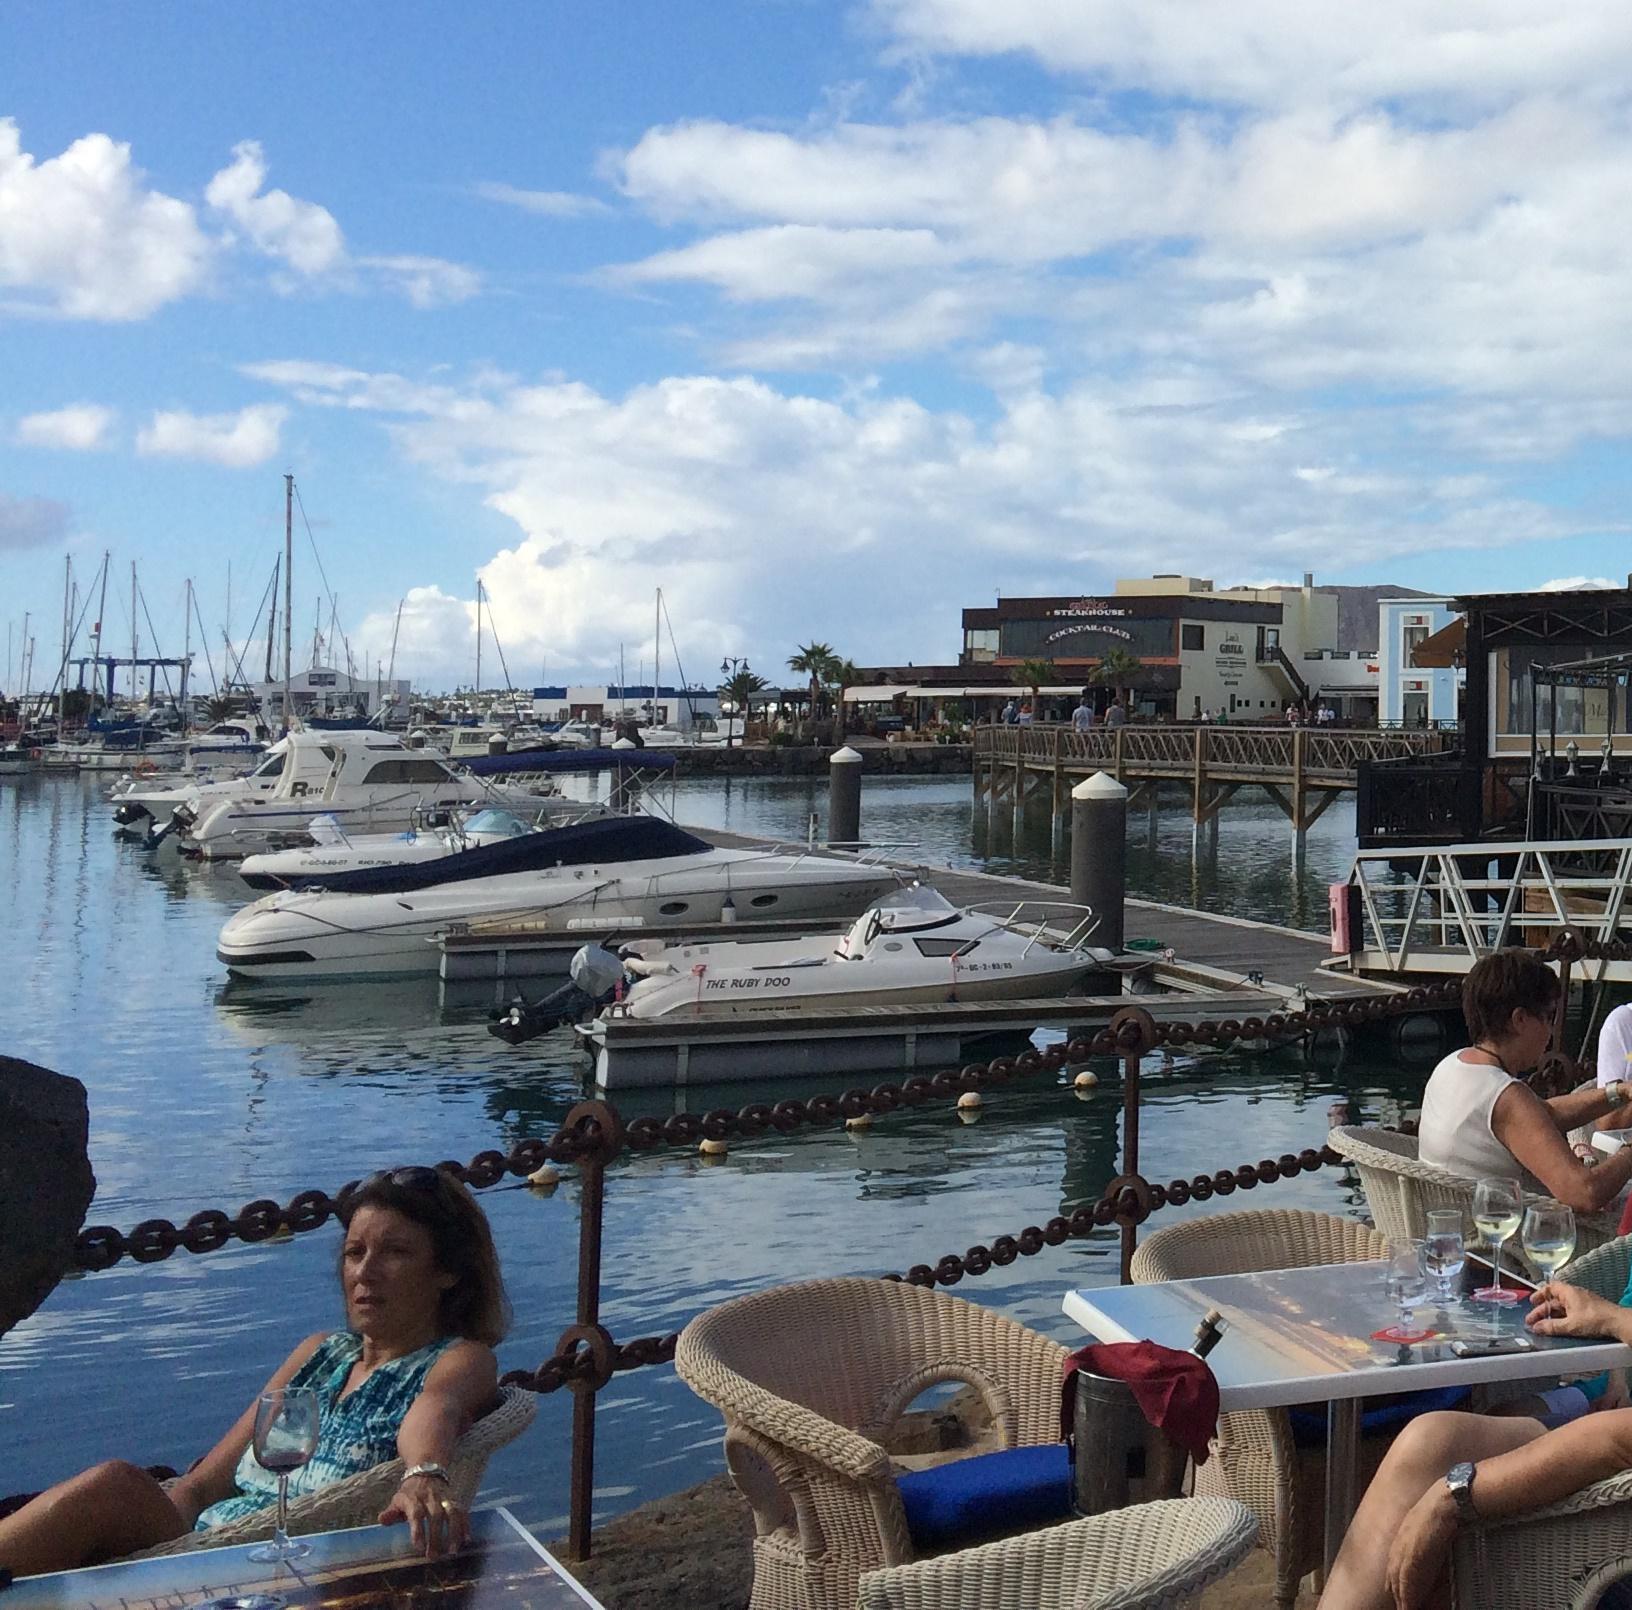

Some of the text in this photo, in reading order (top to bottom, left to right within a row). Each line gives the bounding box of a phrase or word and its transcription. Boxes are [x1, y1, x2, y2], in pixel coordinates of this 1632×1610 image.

[1049, 624, 1131, 641] COCKTAIL CLUB
[1219, 643, 1244, 654] GRILL
[706, 976, 791, 989] THE RUBY DOO
